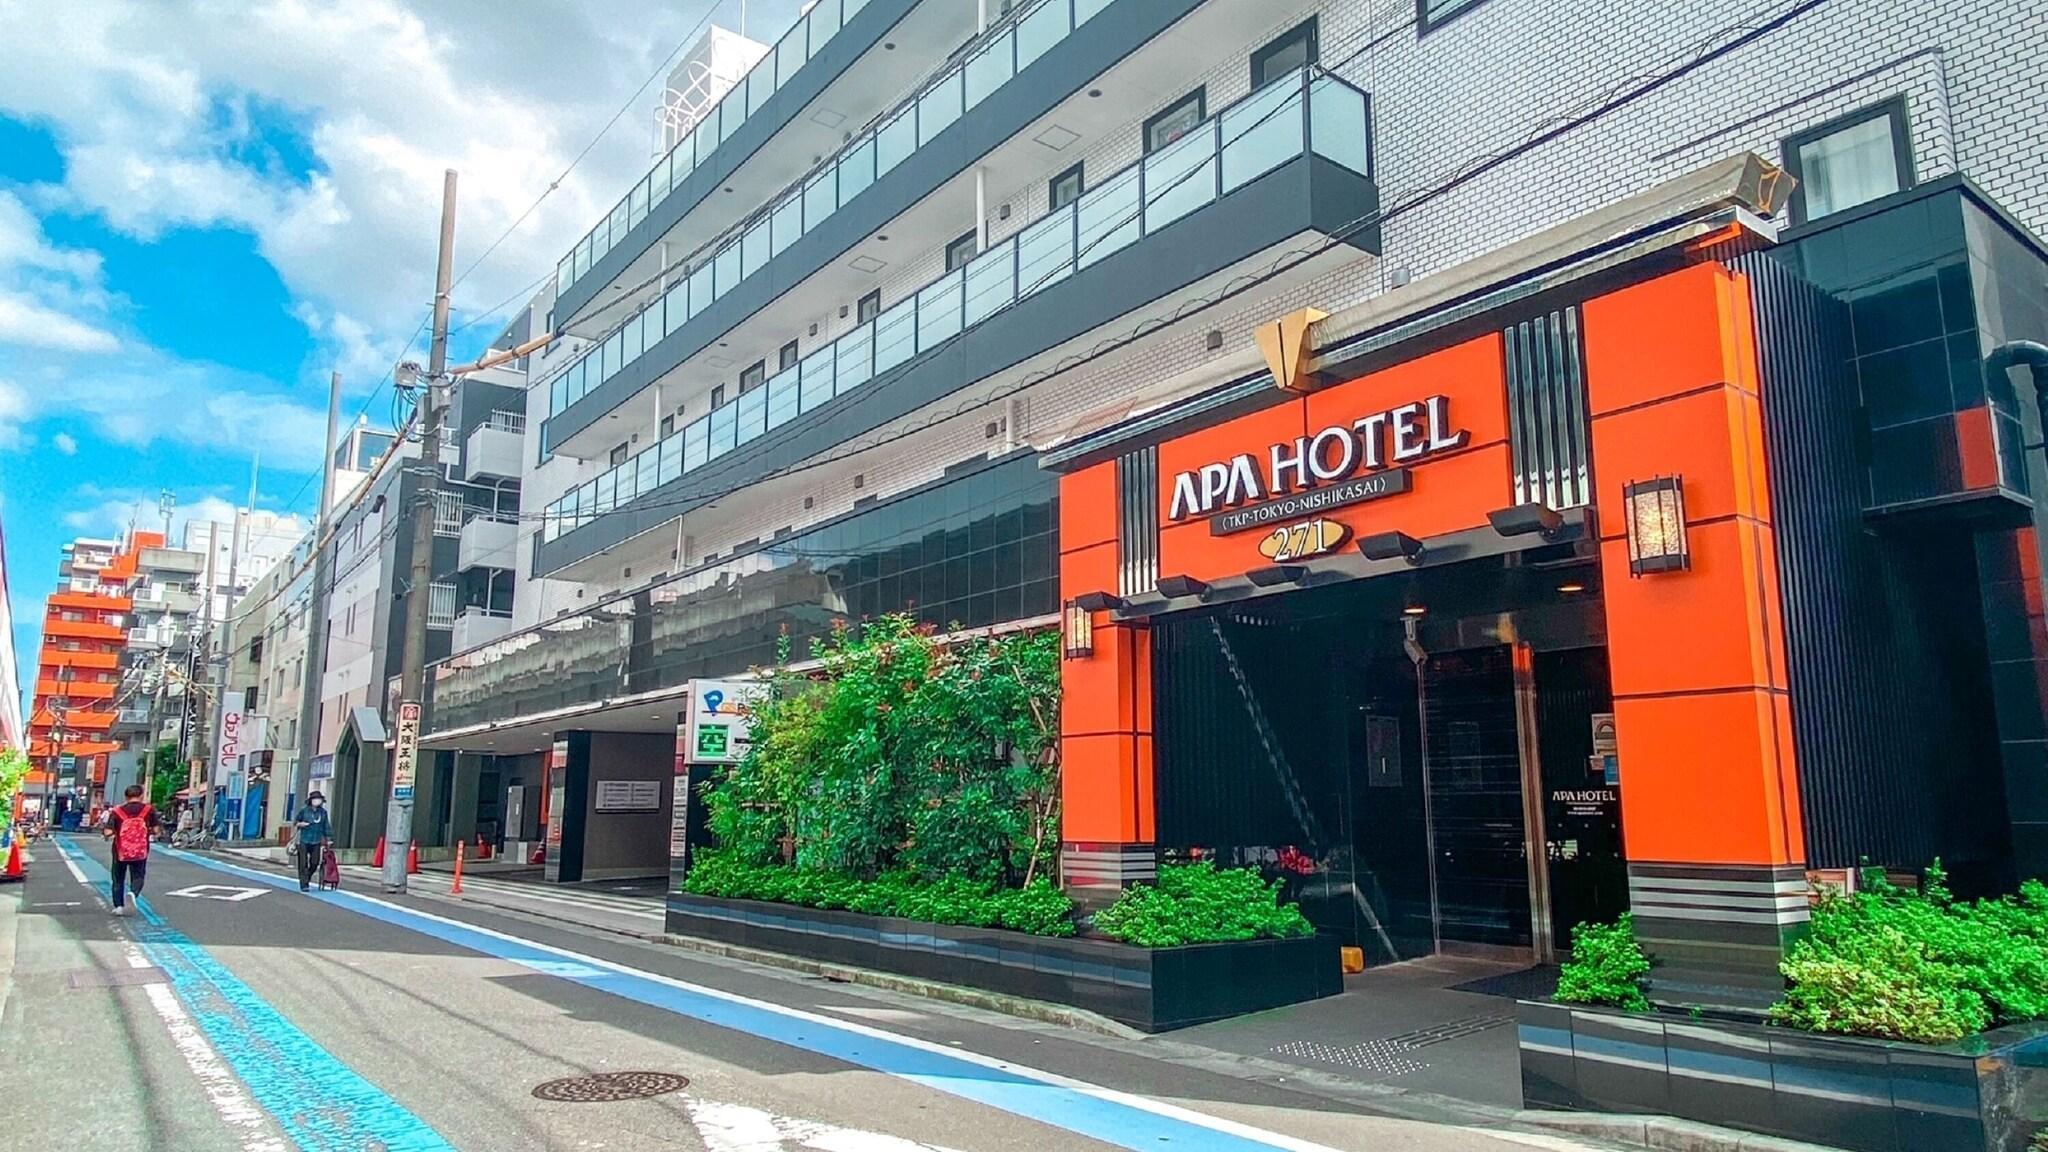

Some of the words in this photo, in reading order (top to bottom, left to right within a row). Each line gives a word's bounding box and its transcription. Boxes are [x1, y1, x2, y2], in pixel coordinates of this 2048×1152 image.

[1169, 454, 1262, 520] APA
[1270, 396, 1465, 494] HOTEL
[1274, 518, 1327, 562] 271
[1553, 790, 1575, 801] APA
[1577, 790, 1616, 801] HOTEL
